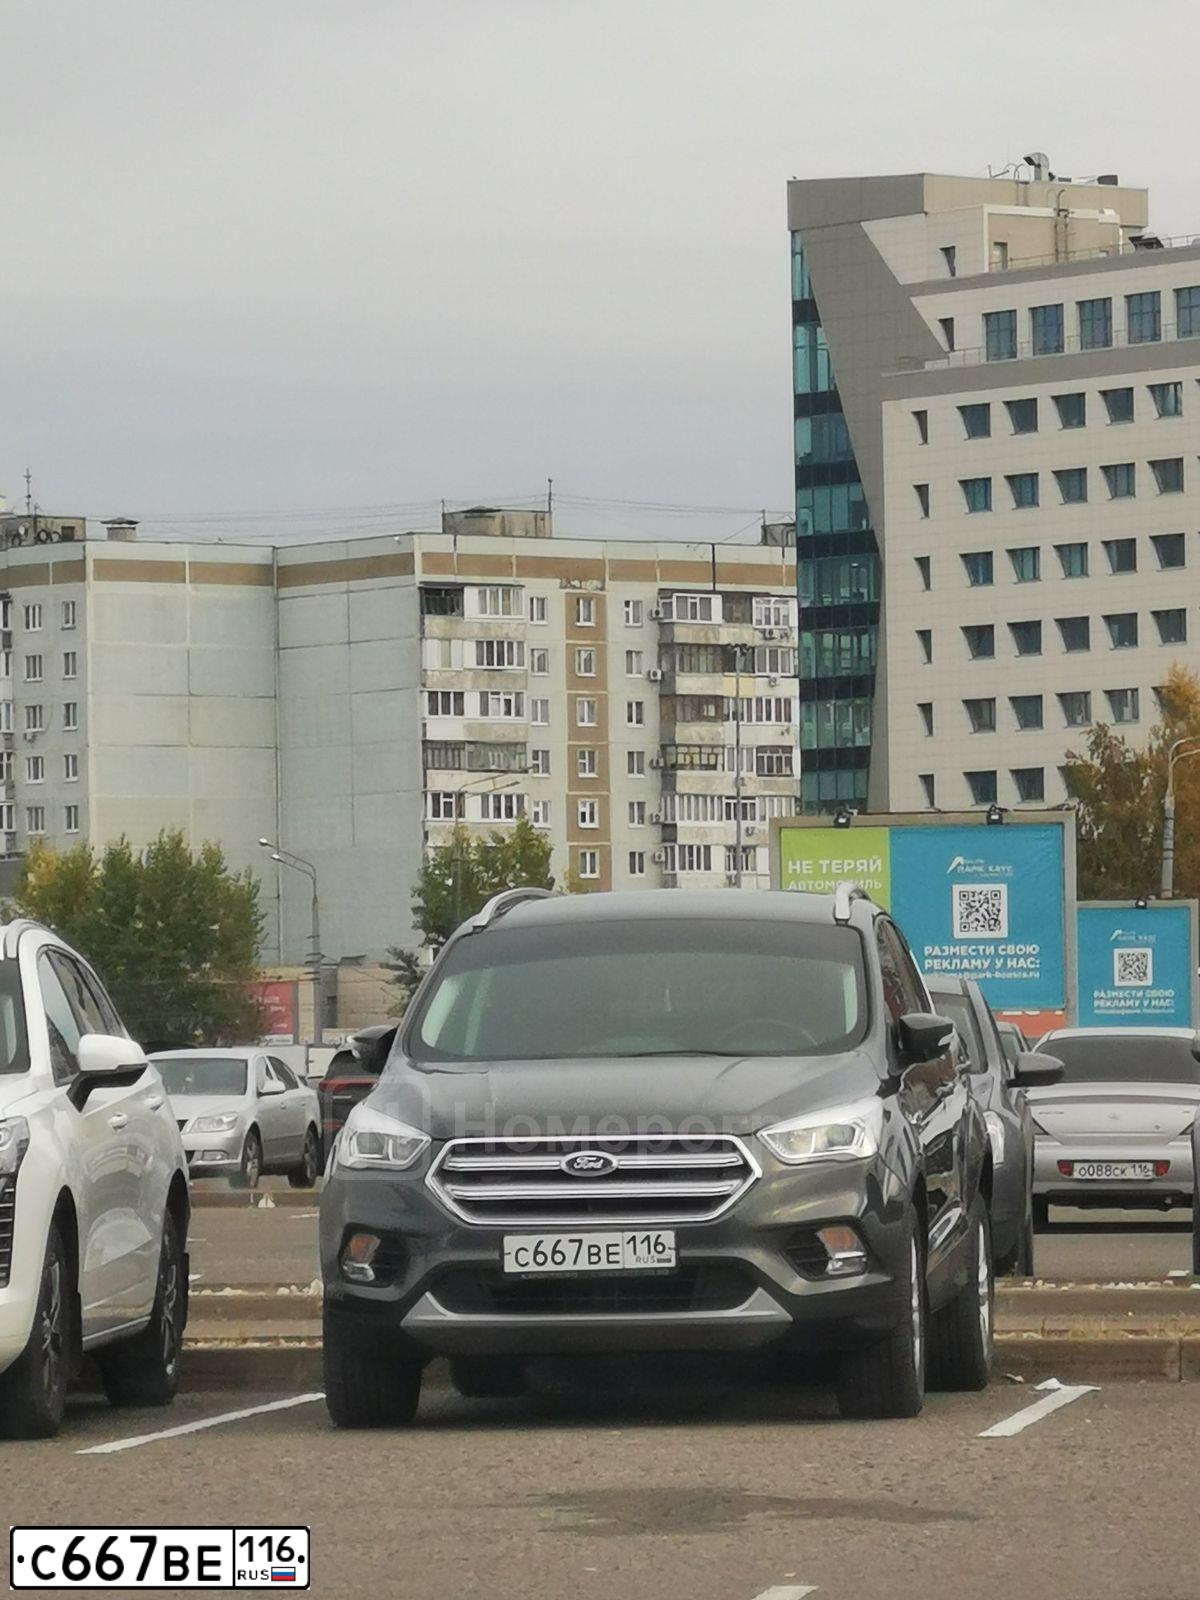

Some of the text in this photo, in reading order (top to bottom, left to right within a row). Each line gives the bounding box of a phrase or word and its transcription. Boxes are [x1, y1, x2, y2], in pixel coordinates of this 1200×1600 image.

[788, 855, 882, 874] НЕ ТЕРЯЙ
[787, 880, 882, 890] АВТОМИЛЬ
[924, 944, 1040, 956] РАЗМЕСТИ СВОЮ
[924, 957, 1041, 970] РЕКЛАМУ У НАС:
[573, 1156, 604, 1170] Ford
[514, 1234, 666, 1267] С667ВЕ 116
[635, 1256, 656, 1264] RUS
